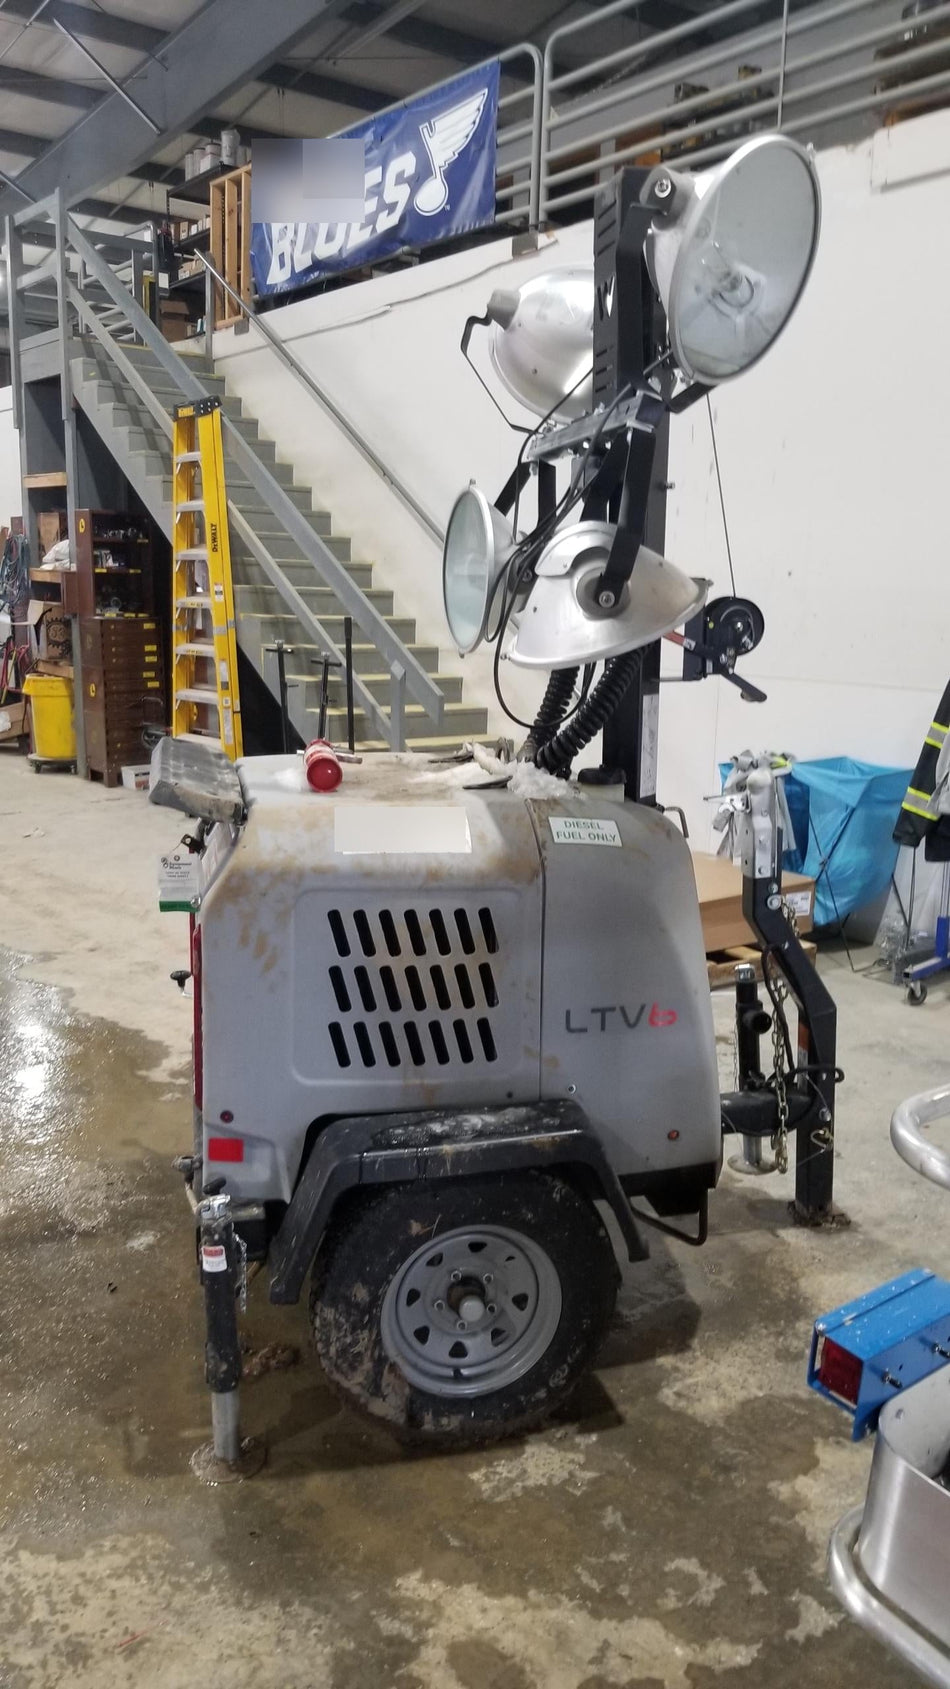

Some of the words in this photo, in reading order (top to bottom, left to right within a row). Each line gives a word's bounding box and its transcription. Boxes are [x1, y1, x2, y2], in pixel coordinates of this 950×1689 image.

[564, 820, 604, 830] DIESEL
[556, 831, 585, 840] FUEL
[588, 832, 616, 842] ONLY
